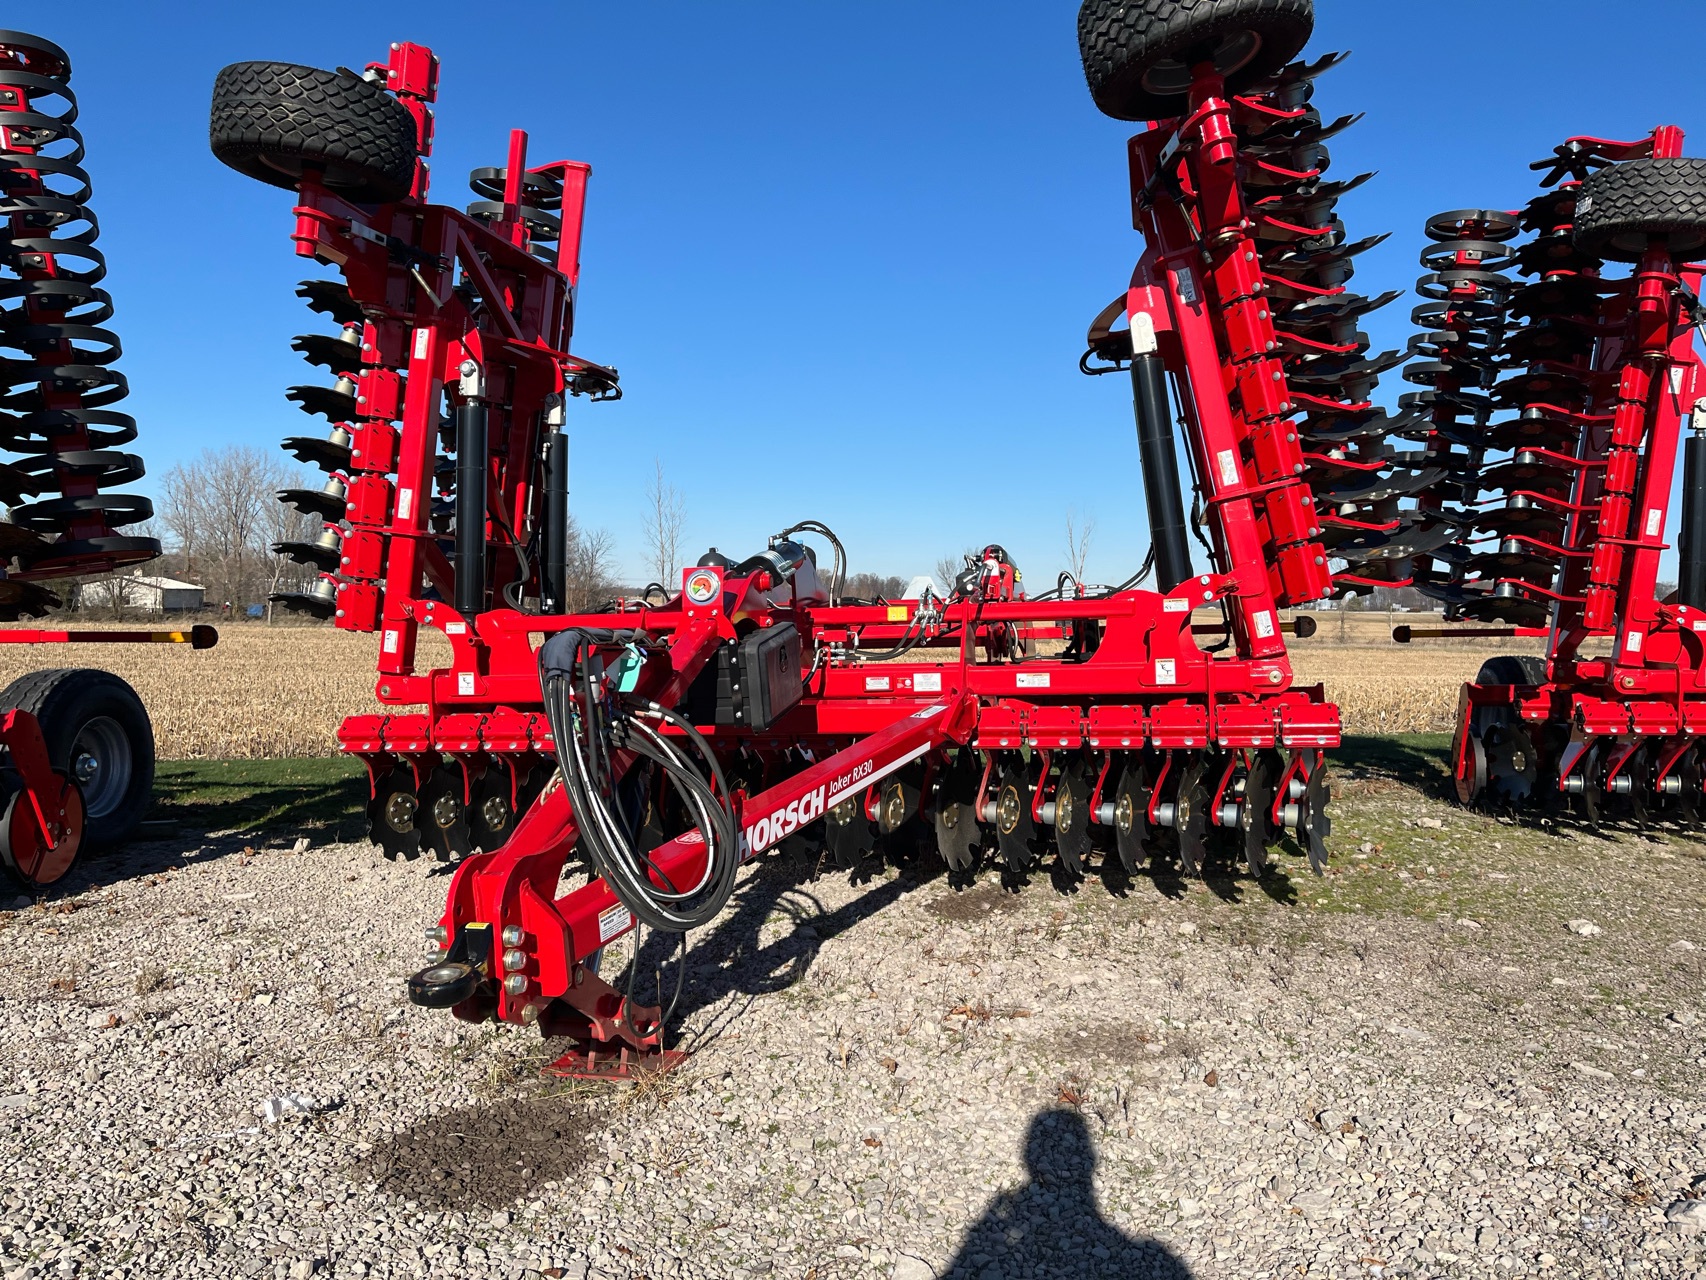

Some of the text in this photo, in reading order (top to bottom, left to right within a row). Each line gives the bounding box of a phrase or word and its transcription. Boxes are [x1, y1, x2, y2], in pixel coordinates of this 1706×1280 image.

[829, 759, 873, 796] Joker RX30
[738, 785, 826, 863] HORSCH
